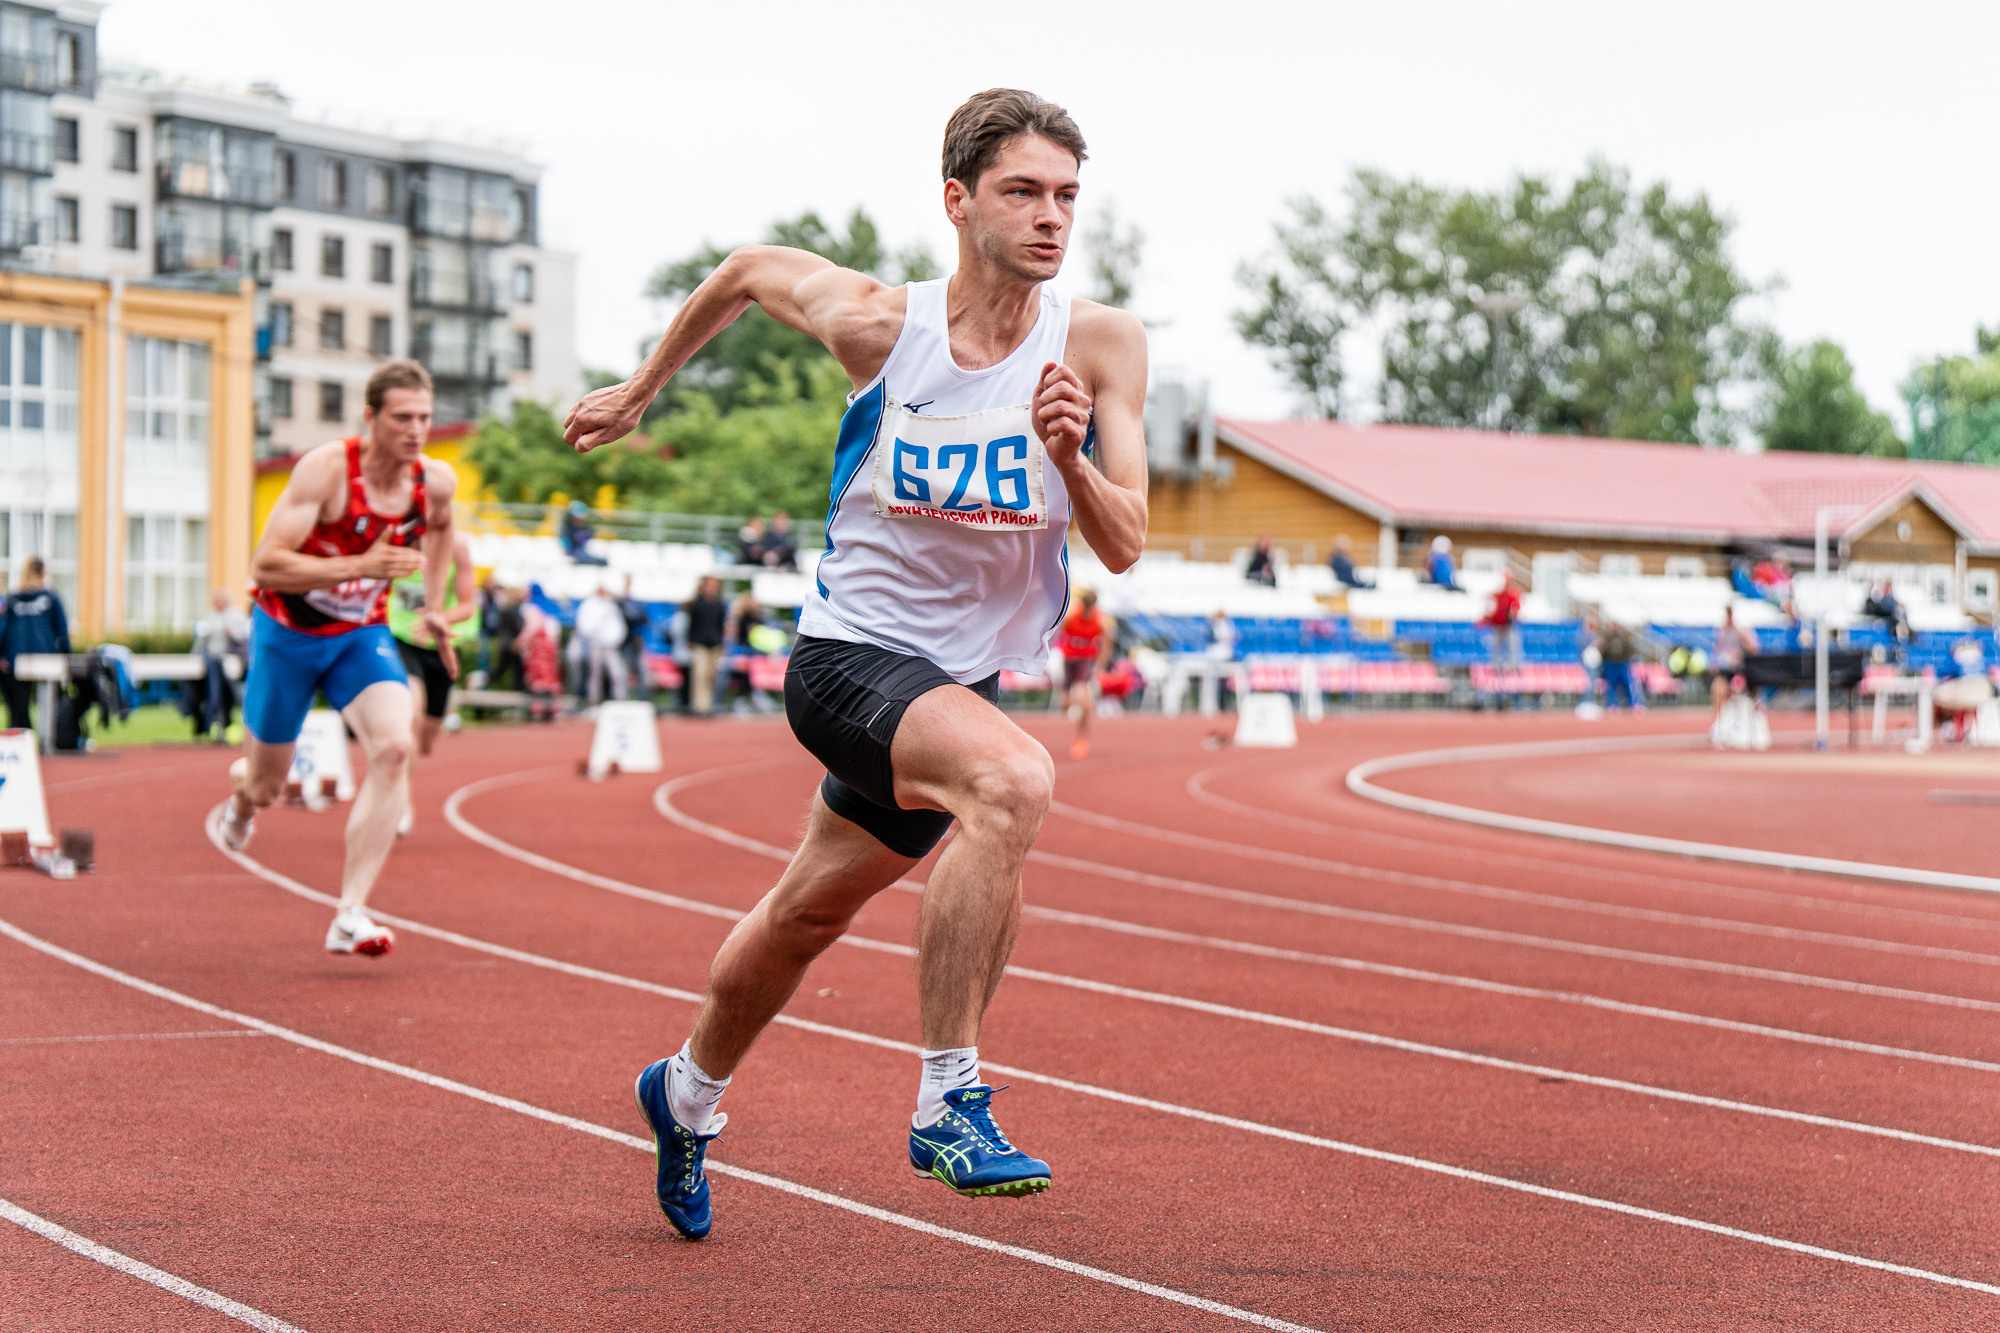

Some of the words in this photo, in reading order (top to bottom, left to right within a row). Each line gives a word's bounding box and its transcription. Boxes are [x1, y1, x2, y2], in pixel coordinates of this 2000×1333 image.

[893, 435, 1031, 511] 626
[888, 505, 988, 524] ФРУНЗЕНСКИЙ
[990, 510, 1038, 525] РАЙОН
